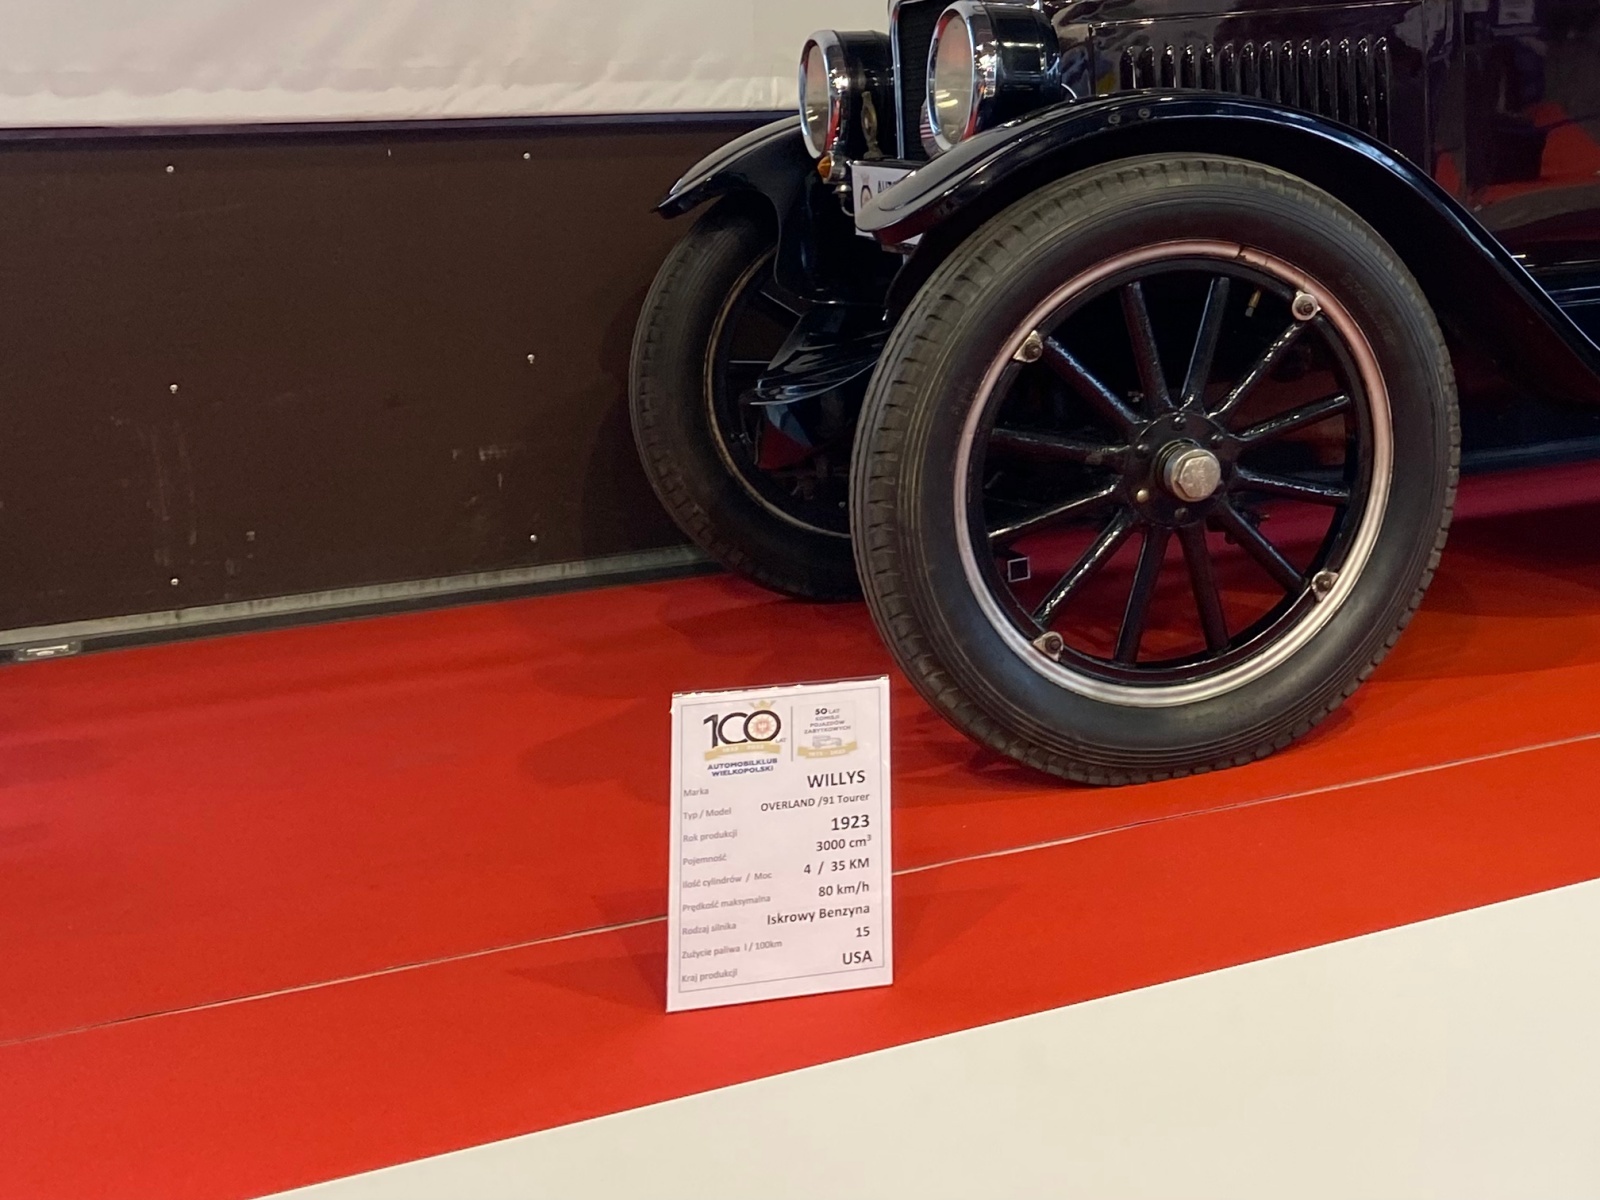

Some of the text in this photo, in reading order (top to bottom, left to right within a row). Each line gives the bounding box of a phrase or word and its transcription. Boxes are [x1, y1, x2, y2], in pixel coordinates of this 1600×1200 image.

[815, 708, 828, 716] 50
[807, 770, 866, 789] WILLYS
[683, 787, 709, 797] Marka
[760, 793, 870, 812] OVERLAND /91 Tourer
[683, 811, 698, 821] Typ
[705, 807, 732, 818] Model
[831, 814, 870, 831] 1923
[683, 830, 738, 843] Rok produkcji
[816, 839, 846, 852] 3000
[803, 864, 811, 875] 4
[830, 860, 845, 872] 35
[849, 857, 870, 870] KM
[754, 872, 772, 881] Moc
[818, 881, 870, 897] 80 km/h
[767, 904, 870, 926] Iskrowy Benzyna
[855, 926, 870, 938] 15
[842, 950, 873, 965] USA
[682, 968, 738, 984] Kraj produkcji
